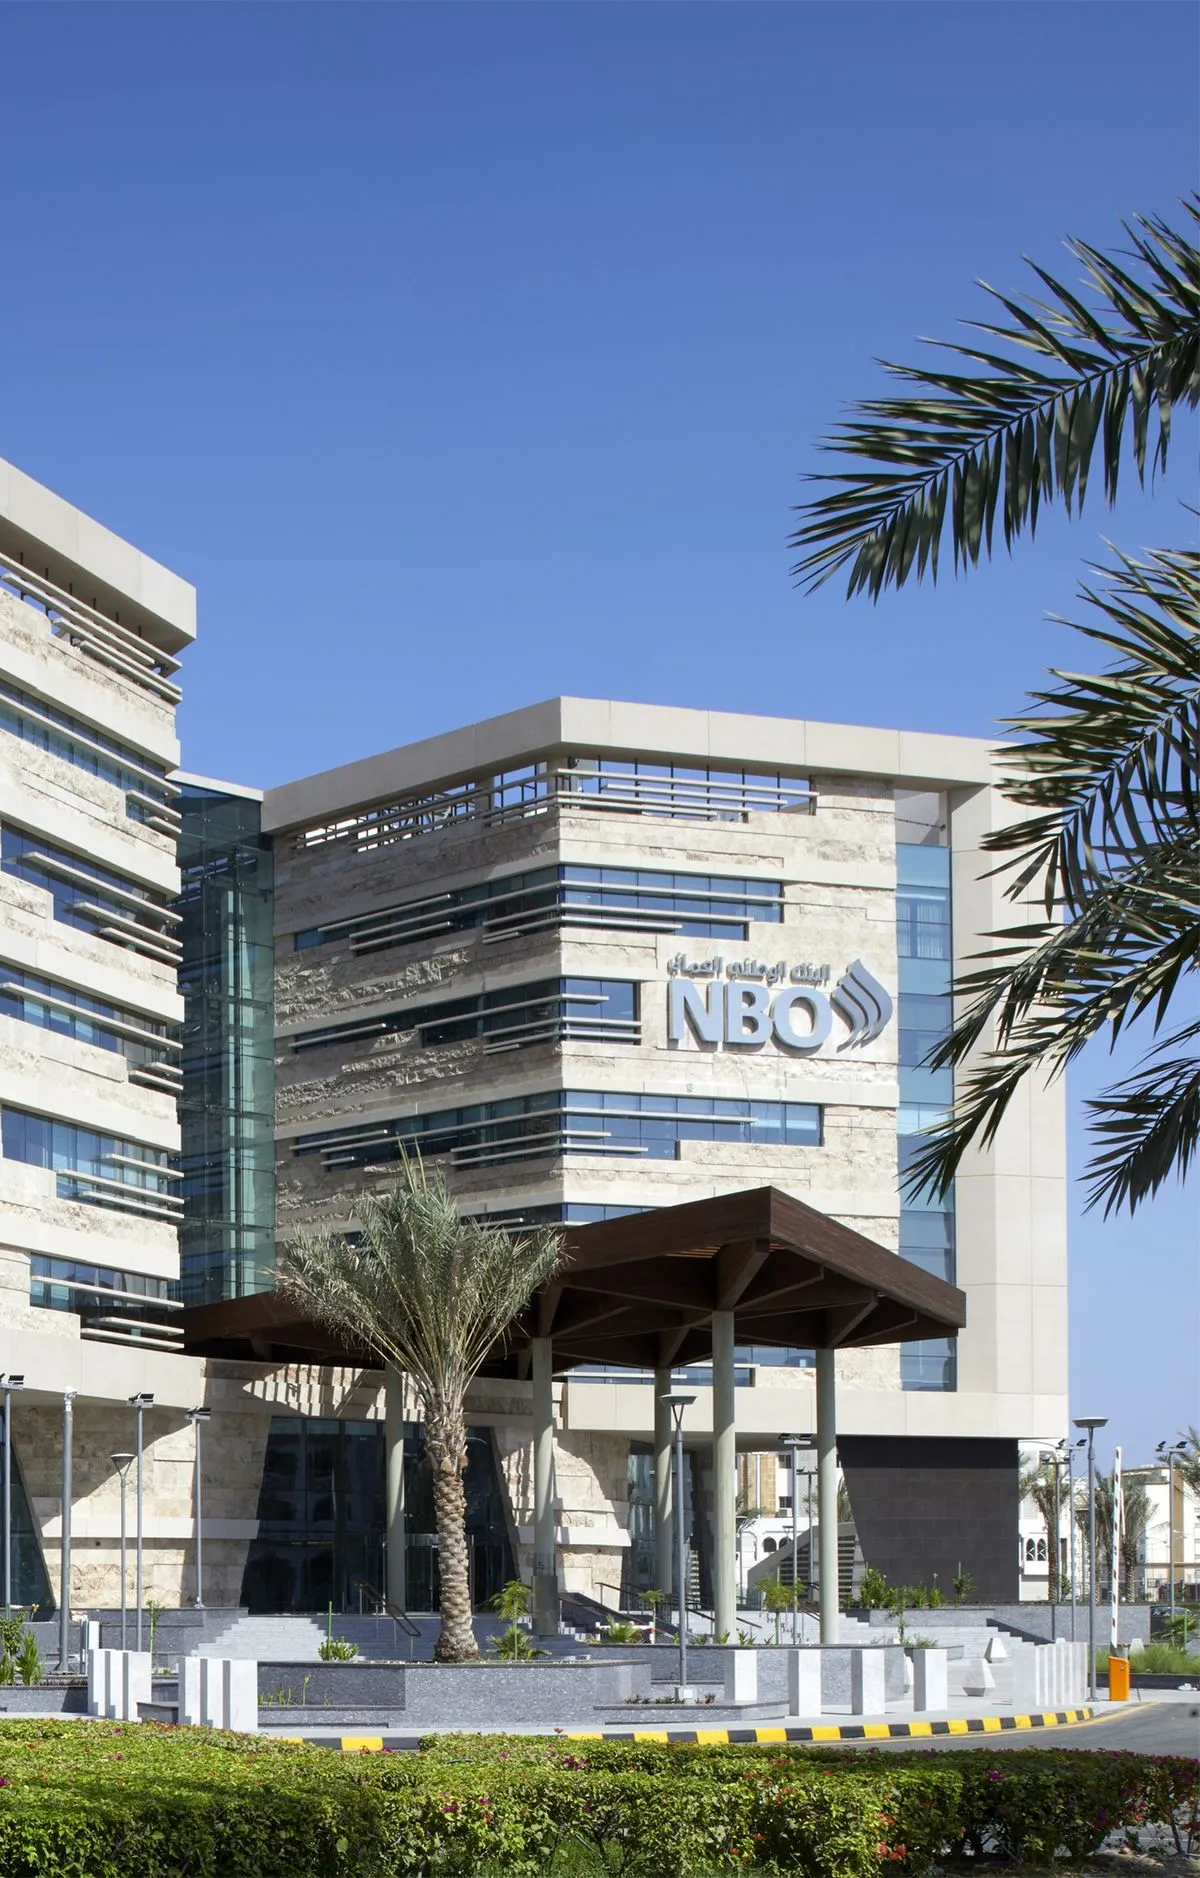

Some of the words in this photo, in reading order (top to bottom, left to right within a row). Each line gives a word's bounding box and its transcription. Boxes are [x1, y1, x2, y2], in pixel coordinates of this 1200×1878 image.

[667, 951, 723, 977] العماني
[726, 957, 785, 984] الوطني
[789, 961, 830, 986] البنك
[669, 978, 833, 1049] NBO
